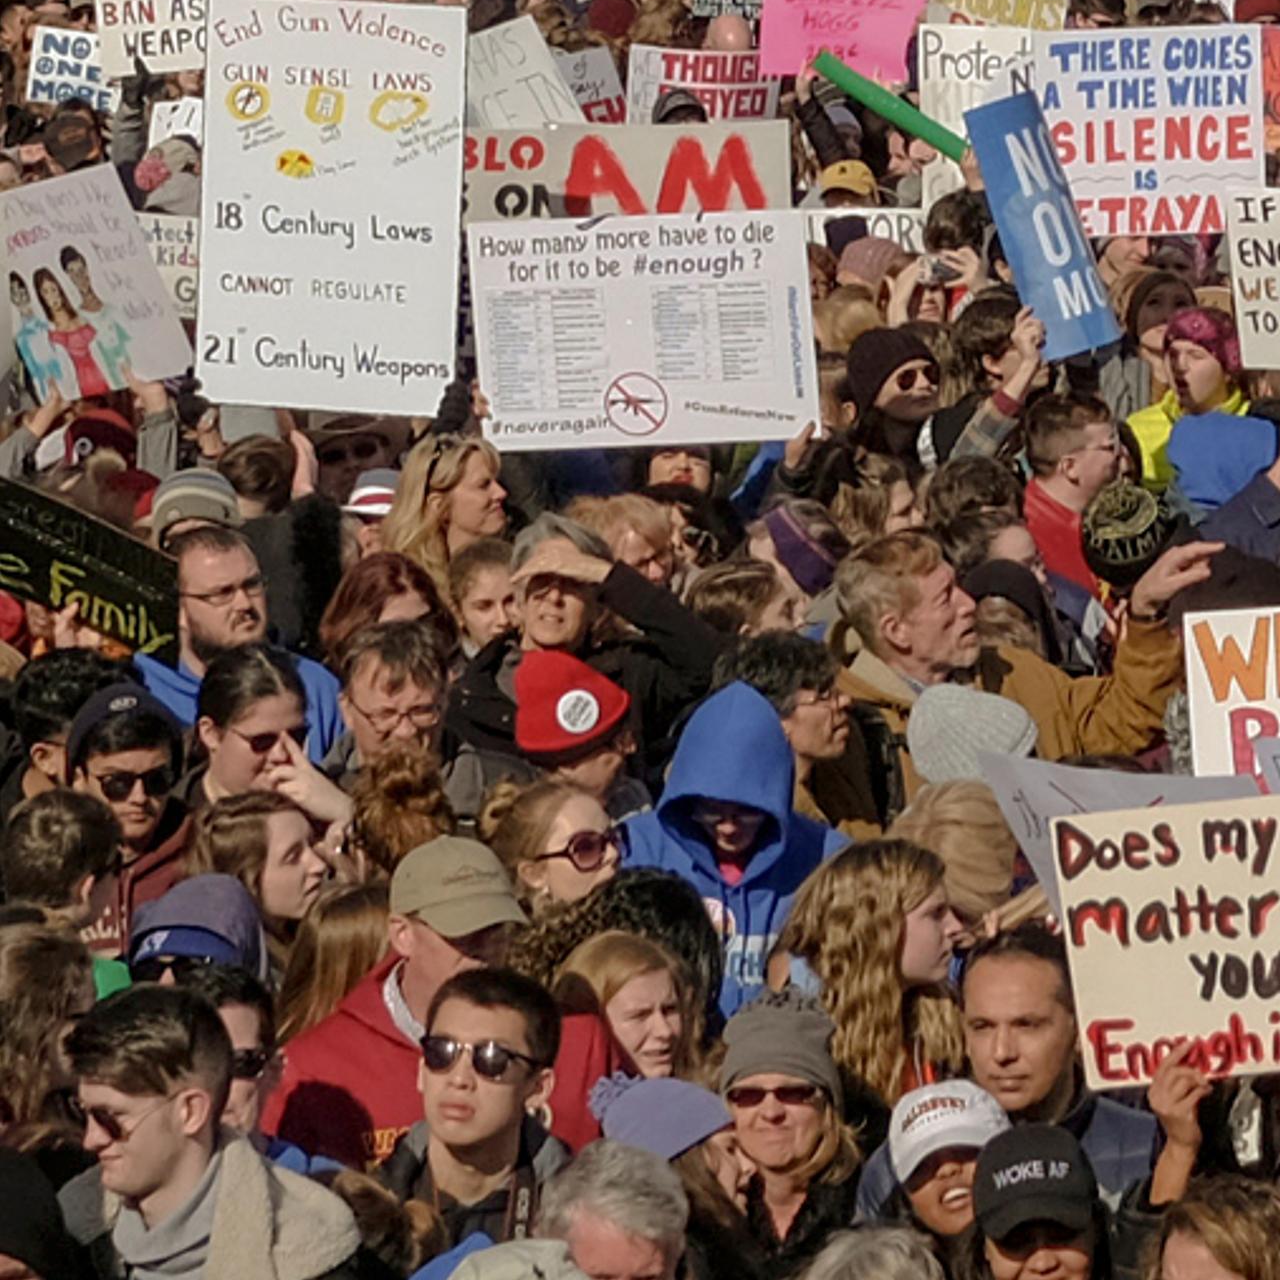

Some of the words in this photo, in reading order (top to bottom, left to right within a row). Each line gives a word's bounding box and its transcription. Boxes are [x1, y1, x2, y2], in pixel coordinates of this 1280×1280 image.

[215, 11, 262, 48] End
[278, 6, 328, 32] Gun
[339, 8, 447, 57] Violence
[1050, 39, 1150, 74] THERE
[1162, 35, 1252, 72] COMES
[1056, 115, 1253, 164] SILENCE
[1236, 198, 1276, 224] IF
[479, 237, 525, 258] How
[532, 236, 587, 254] many
[596, 232, 650, 249] more
[659, 226, 707, 246] have
[714, 226, 736, 243] to
[742, 221, 774, 243] die
[221, 274, 293, 296] CANNOT
[312, 280, 406, 302] REGULATE
[48, 561, 174, 652] Family
[1056, 820, 1179, 880] Does
[1202, 816, 1276, 875] my
[993, 1161, 1043, 1190] WOKE
[1048, 1162, 1070, 1179] AF
